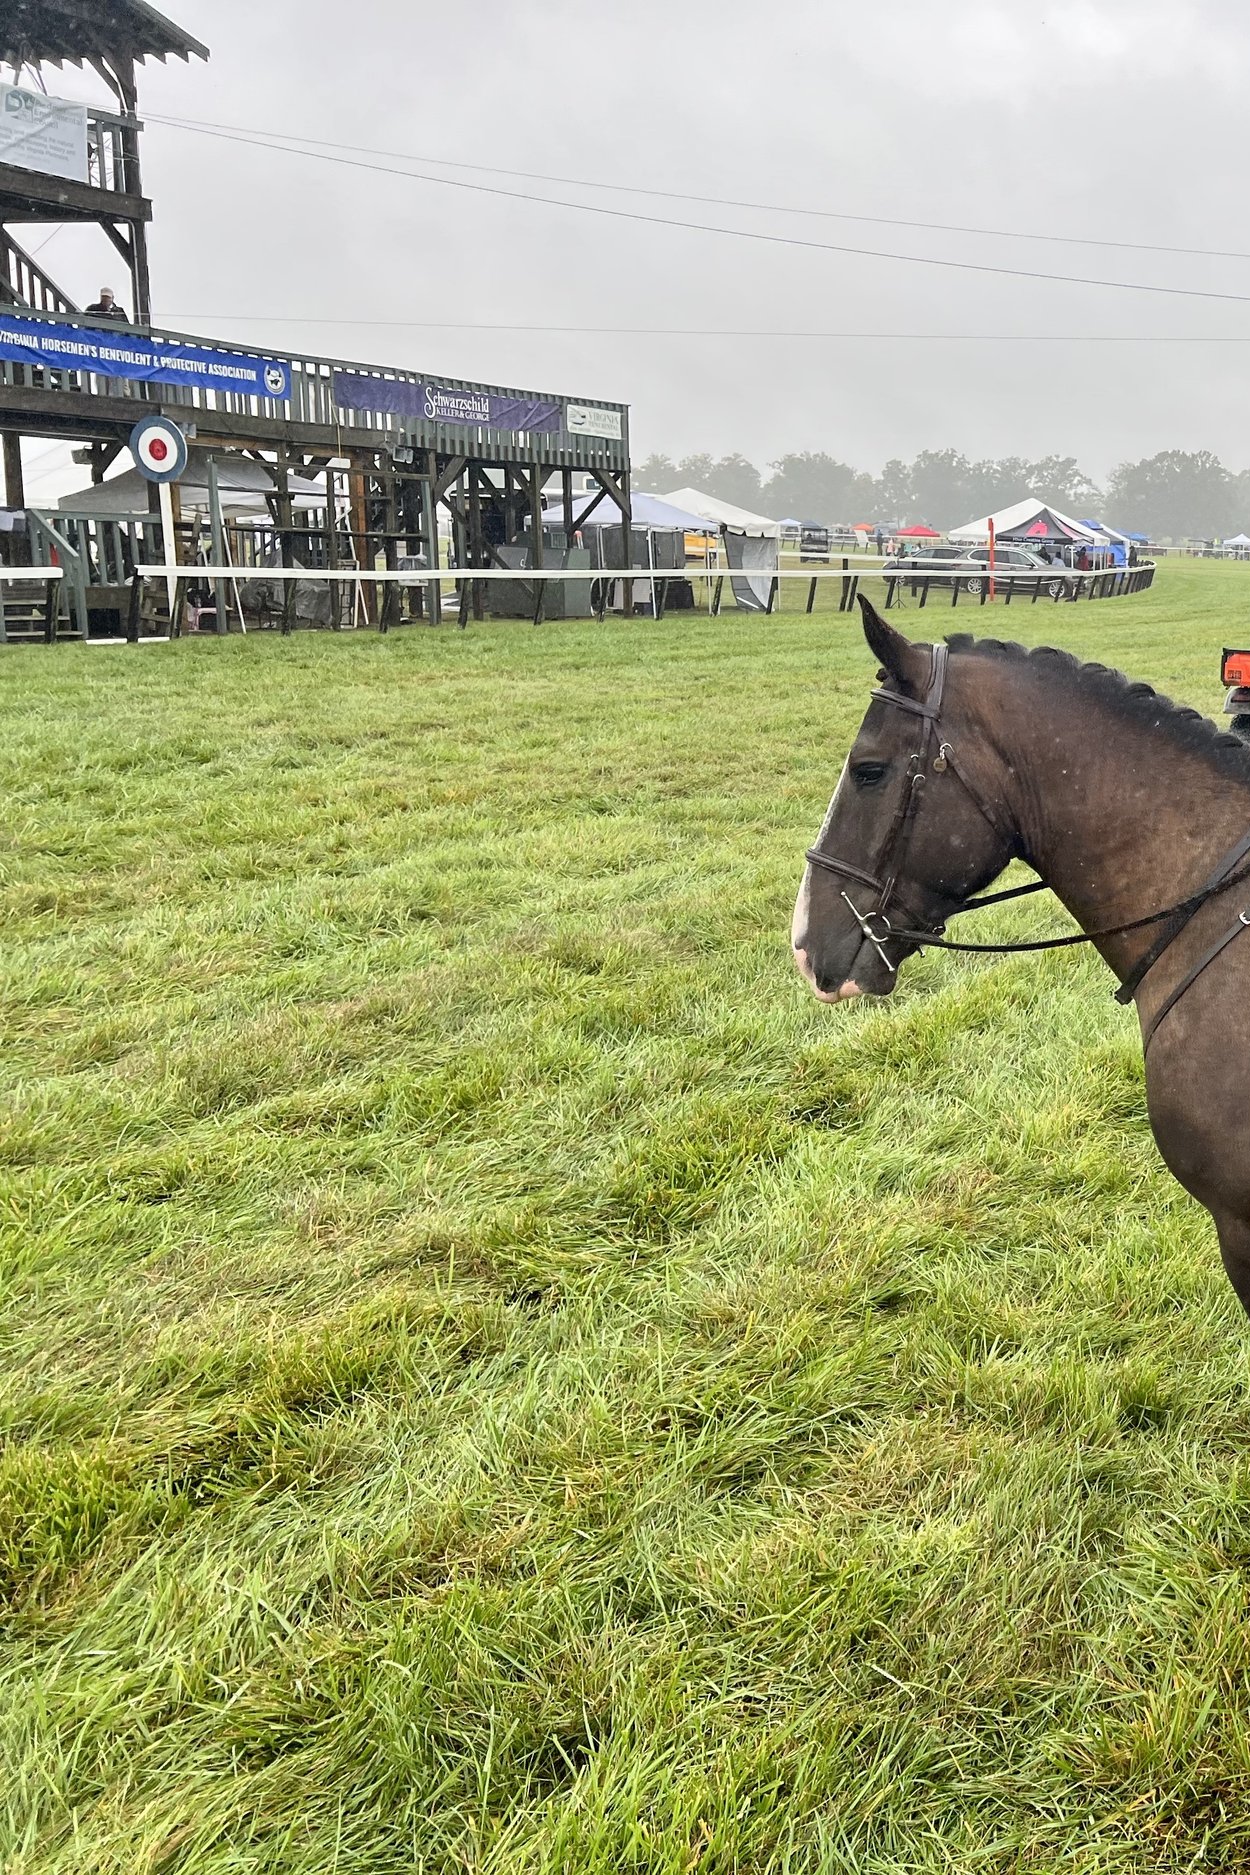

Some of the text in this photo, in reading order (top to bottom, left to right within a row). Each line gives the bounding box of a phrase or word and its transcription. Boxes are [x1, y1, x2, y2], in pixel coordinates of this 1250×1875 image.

[41, 337, 98, 358] HORSEMEN'S
[99, 347, 151, 366] BENEVOLENT
[153, 356, 160, 367] &
[160, 357, 207, 374] PROTECTIVE
[208, 363, 257, 381] ASSOCIATION
[424, 387, 490, 418] Schwarzschild
